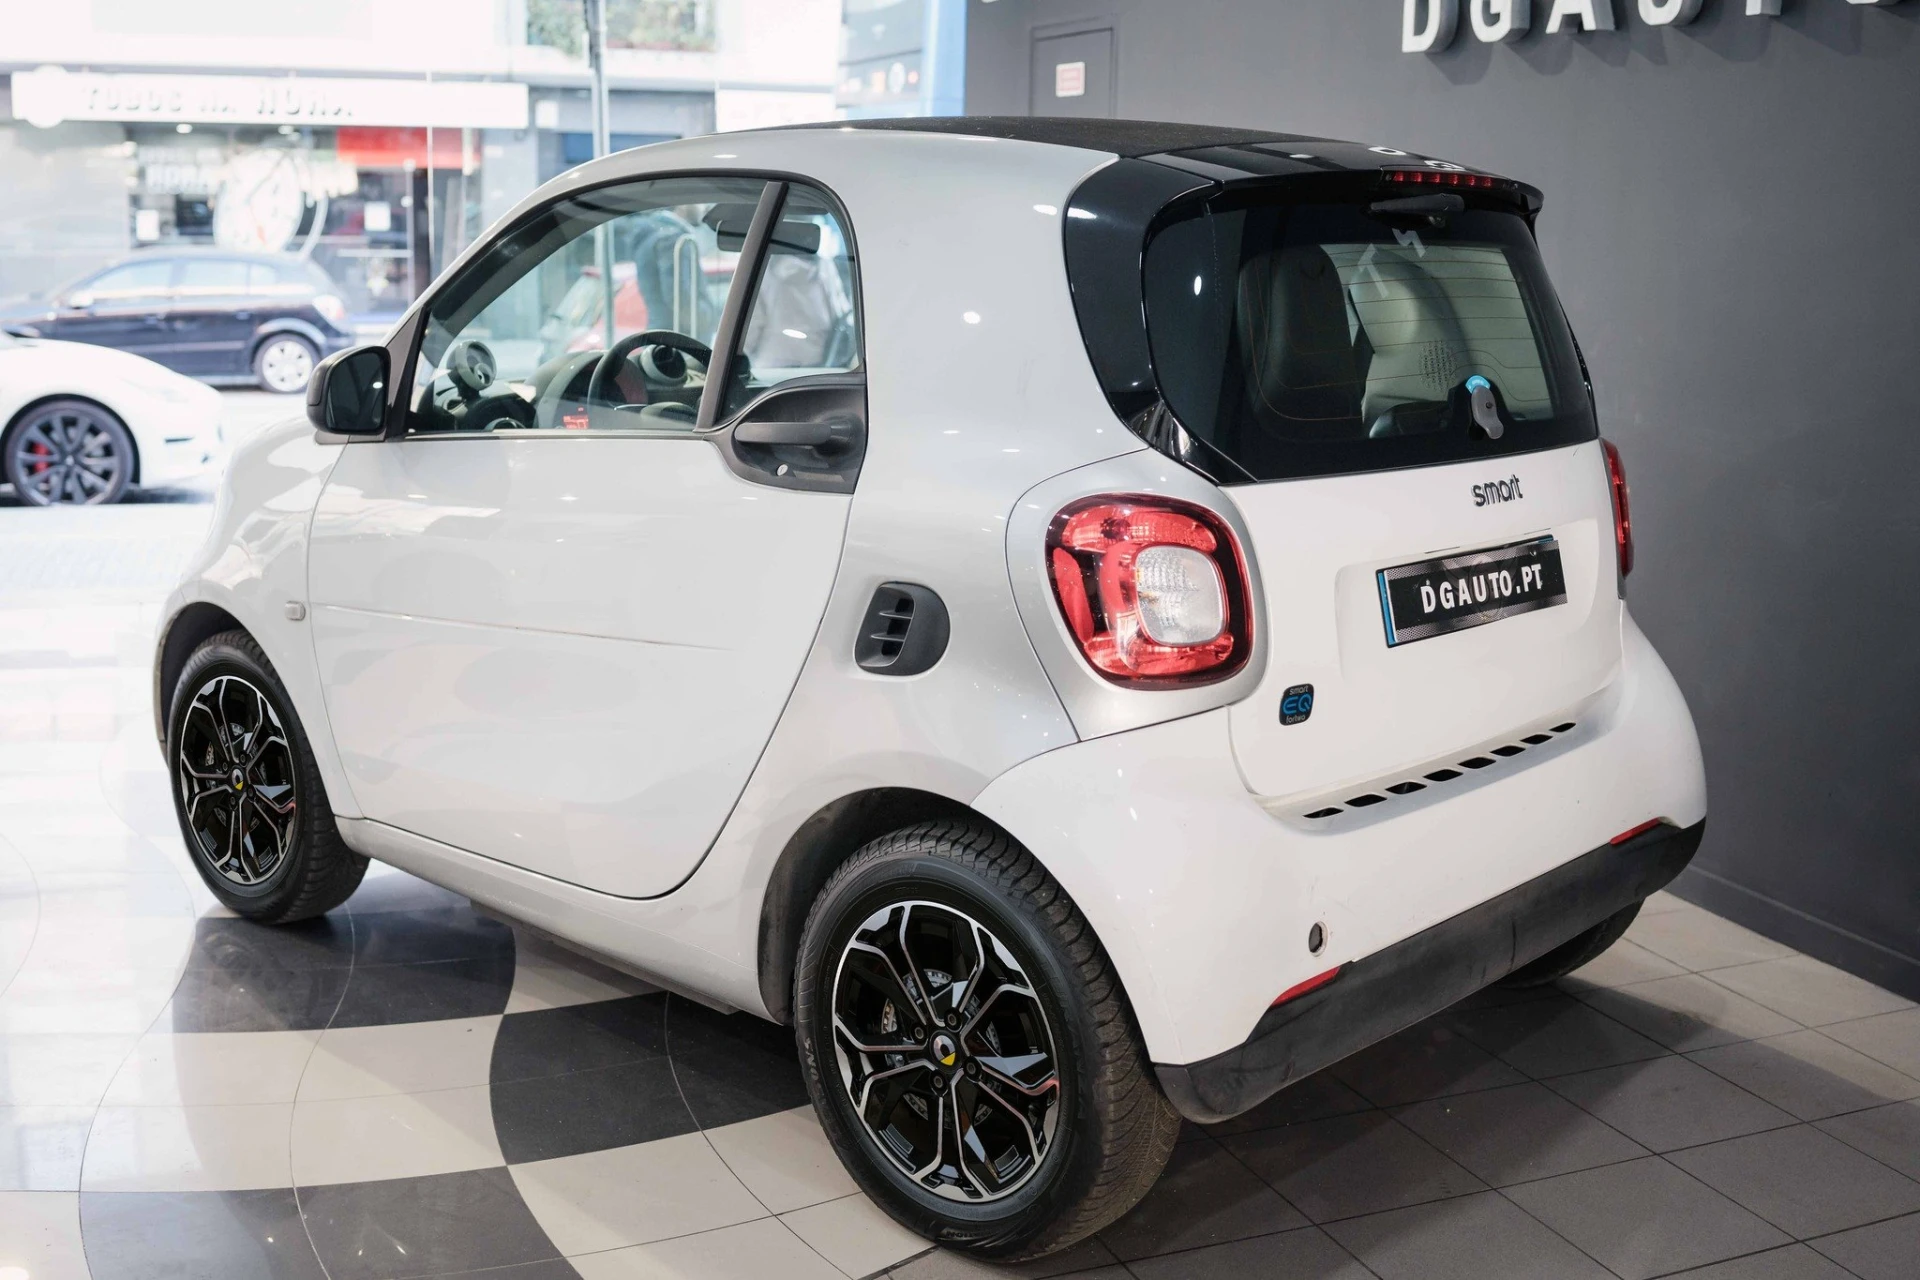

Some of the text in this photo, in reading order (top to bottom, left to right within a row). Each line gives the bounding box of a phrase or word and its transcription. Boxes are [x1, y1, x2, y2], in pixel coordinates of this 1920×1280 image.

[1471, 474, 1523, 507] smart
[1420, 563, 1542, 614] DGAUTO.PT
[1283, 693, 1312, 715] EQ
[1289, 685, 1309, 696] smart
